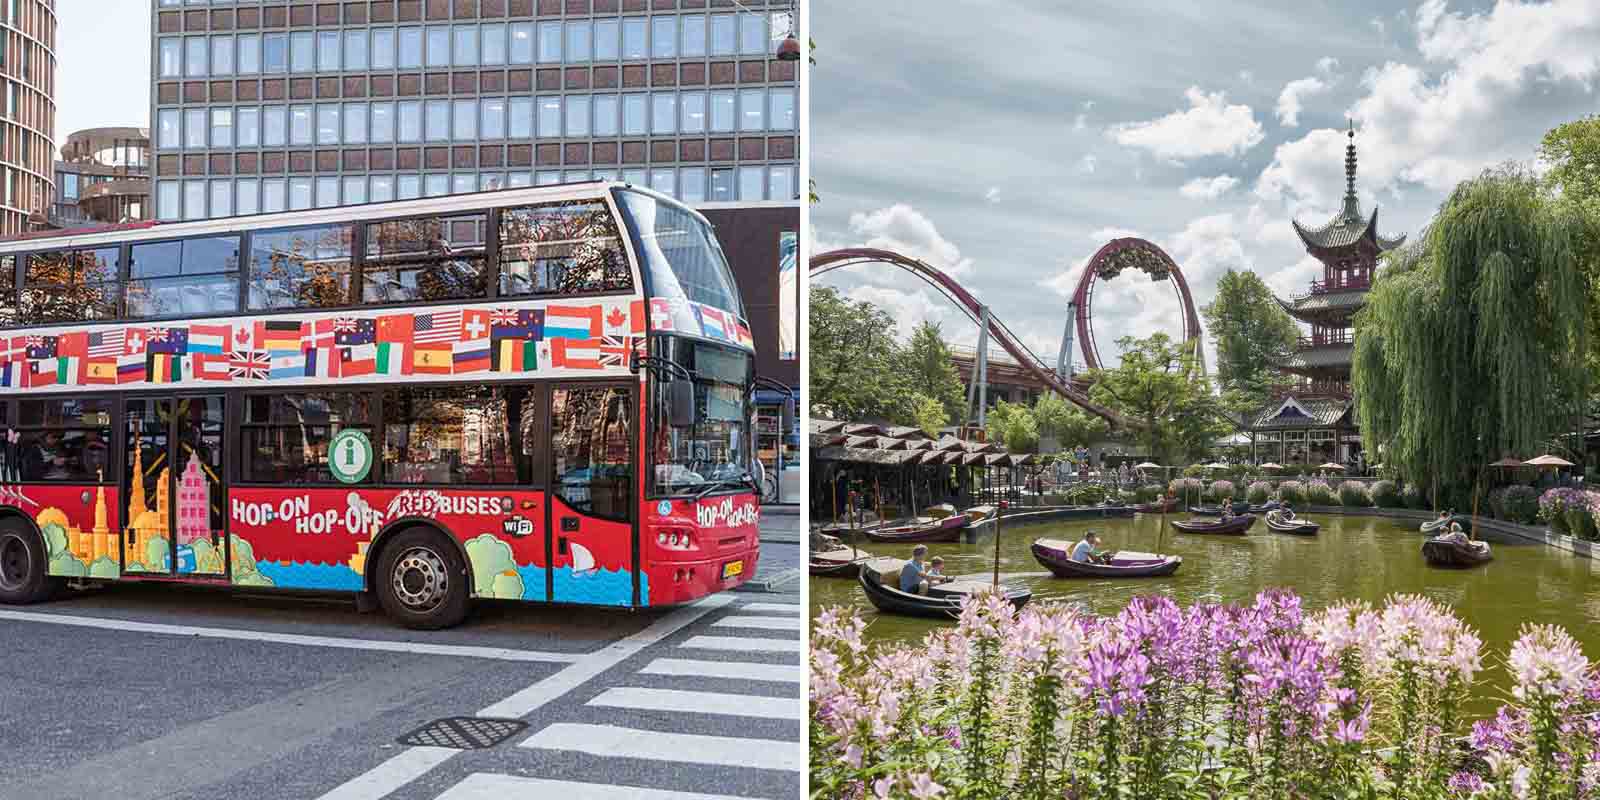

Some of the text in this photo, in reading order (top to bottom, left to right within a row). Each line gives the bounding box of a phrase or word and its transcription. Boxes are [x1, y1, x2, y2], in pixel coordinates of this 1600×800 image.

[232, 495, 309, 526] HOP-ON
[400, 495, 501, 514] RED BUSES
[696, 496, 733, 528] HOP-ON
